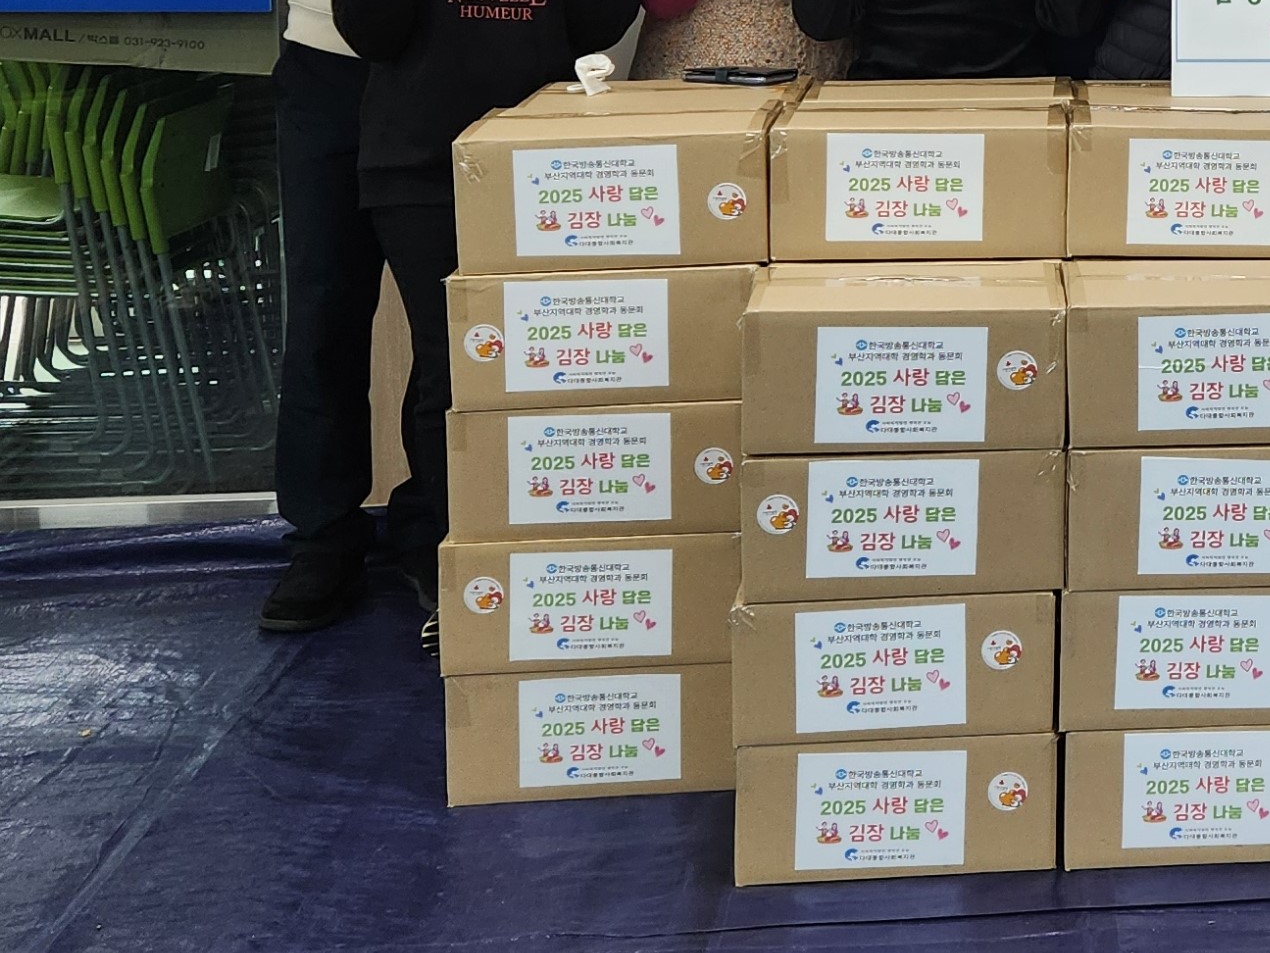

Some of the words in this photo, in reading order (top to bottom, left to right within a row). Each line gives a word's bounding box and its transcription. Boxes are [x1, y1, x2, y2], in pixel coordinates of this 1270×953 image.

[460, 5, 533, 20] HUMEUR
[124, 36, 205, 50] 031-923-9100
[848, 177, 891, 192] 2025
[896, 174, 930, 192] 사랑
[935, 177, 963, 191] 담은
[537, 188, 583, 204] 2025
[588, 184, 624, 203] 사랑
[628, 185, 659, 201] 담은
[875, 200, 908, 218] 김장
[913, 202, 941, 217] 나눔
[567, 210, 602, 230] 김장
[607, 211, 637, 227] 나눔
[526, 324, 572, 341] 2025
[577, 320, 613, 340] 사랑
[617, 322, 648, 338] 담은
[555, 347, 591, 366] 김장
[595, 348, 625, 364] 나눔
[840, 370, 887, 386] 2025
[892, 367, 930, 387] 사랑
[935, 370, 966, 385] 담은
[869, 394, 906, 414] 김장
[911, 397, 942, 413] 나눔
[530, 455, 575, 471] 2025
[580, 451, 616, 470] 사랑
[620, 453, 650, 468] 담은
[559, 477, 594, 496] 김장
[599, 478, 628, 494] 나눔
[830, 507, 877, 524] 2025
[883, 504, 920, 524] 사랑
[925, 506, 956, 522] 담은
[859, 531, 896, 551] 김장
[901, 534, 932, 550] 나눔
[532, 591, 576, 608] 2025
[581, 588, 617, 607] 사랑
[622, 589, 651, 605] 담은
[560, 614, 594, 633] 김장
[599, 615, 629, 630] 나눔
[1139, 637, 1184, 653] 2025
[1189, 634, 1225, 653] 사랑
[1229, 637, 1259, 652] 담은
[1166, 661, 1201, 680] 김장
[1206, 663, 1236, 679] 나눔
[1145, 778, 1190, 795] 2025
[1195, 775, 1231, 794] 사랑
[1235, 777, 1265, 792] 담은
[1173, 802, 1207, 822] 김장
[1212, 804, 1242, 819] 나눔
